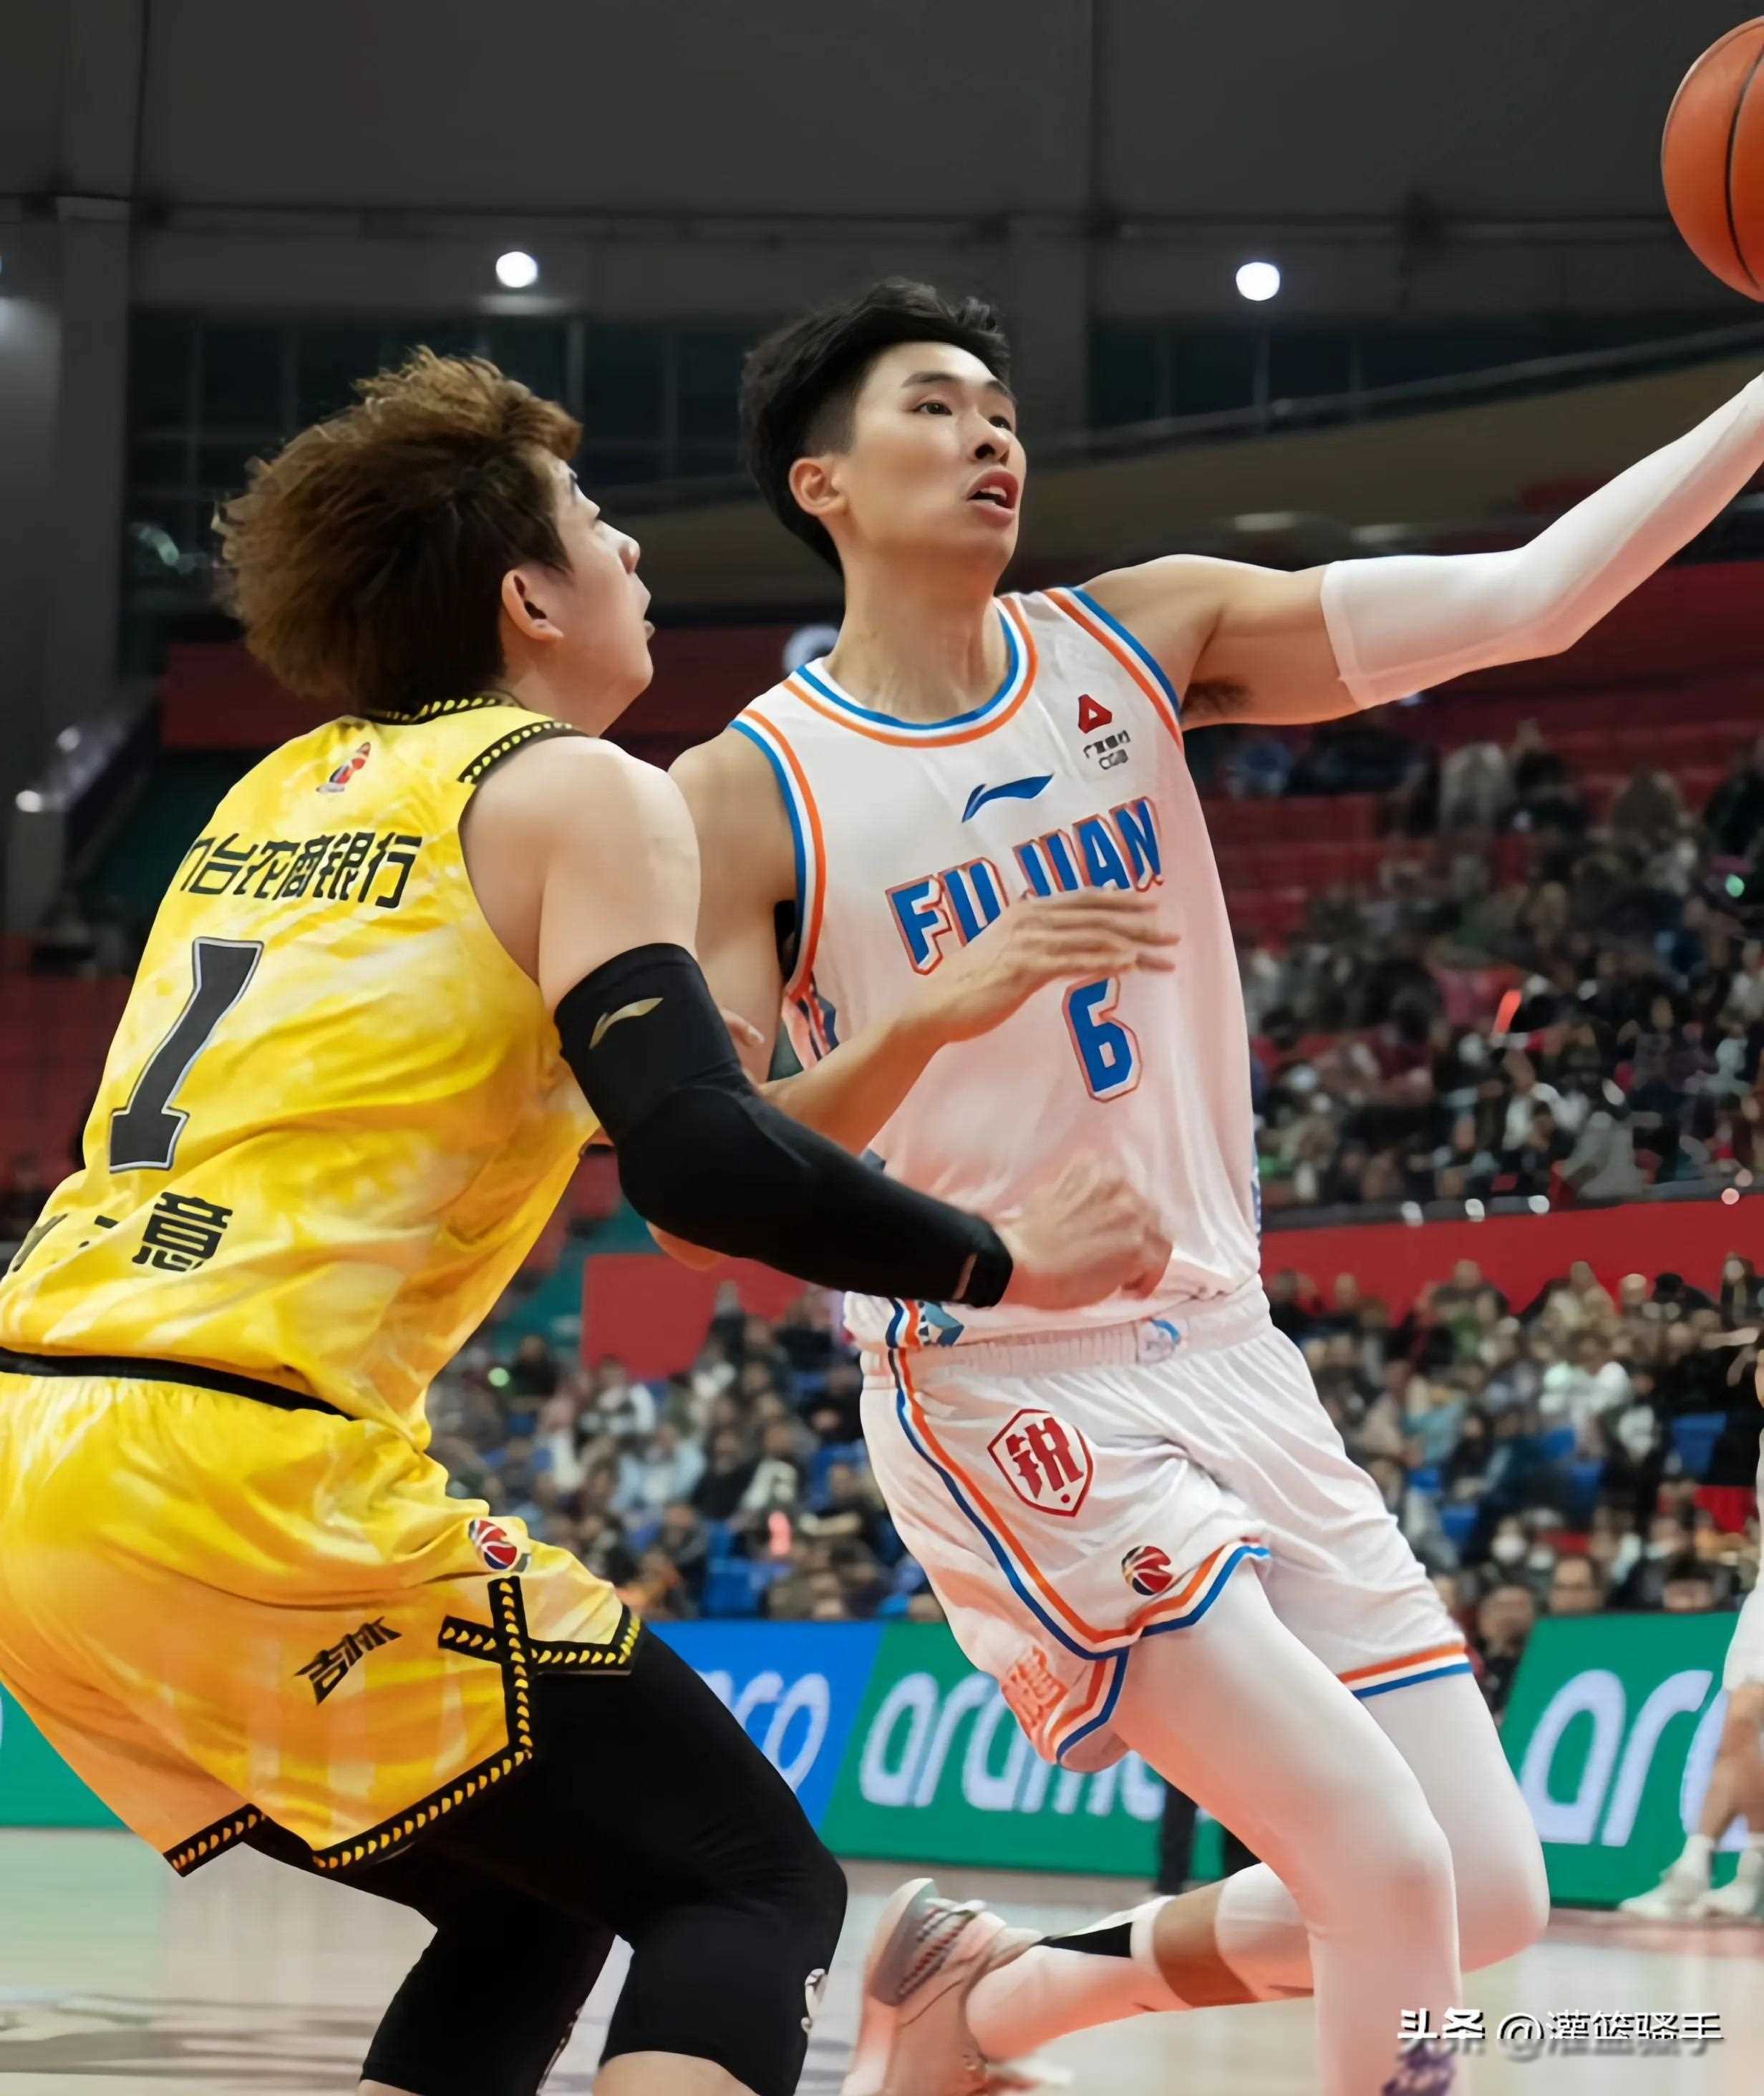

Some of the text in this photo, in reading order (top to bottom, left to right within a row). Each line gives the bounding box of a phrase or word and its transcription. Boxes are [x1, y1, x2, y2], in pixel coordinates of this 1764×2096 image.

[885, 796, 1165, 976] FUJIAN
[109, 936, 264, 1173] 1
[1062, 972, 1143, 1103] 6
